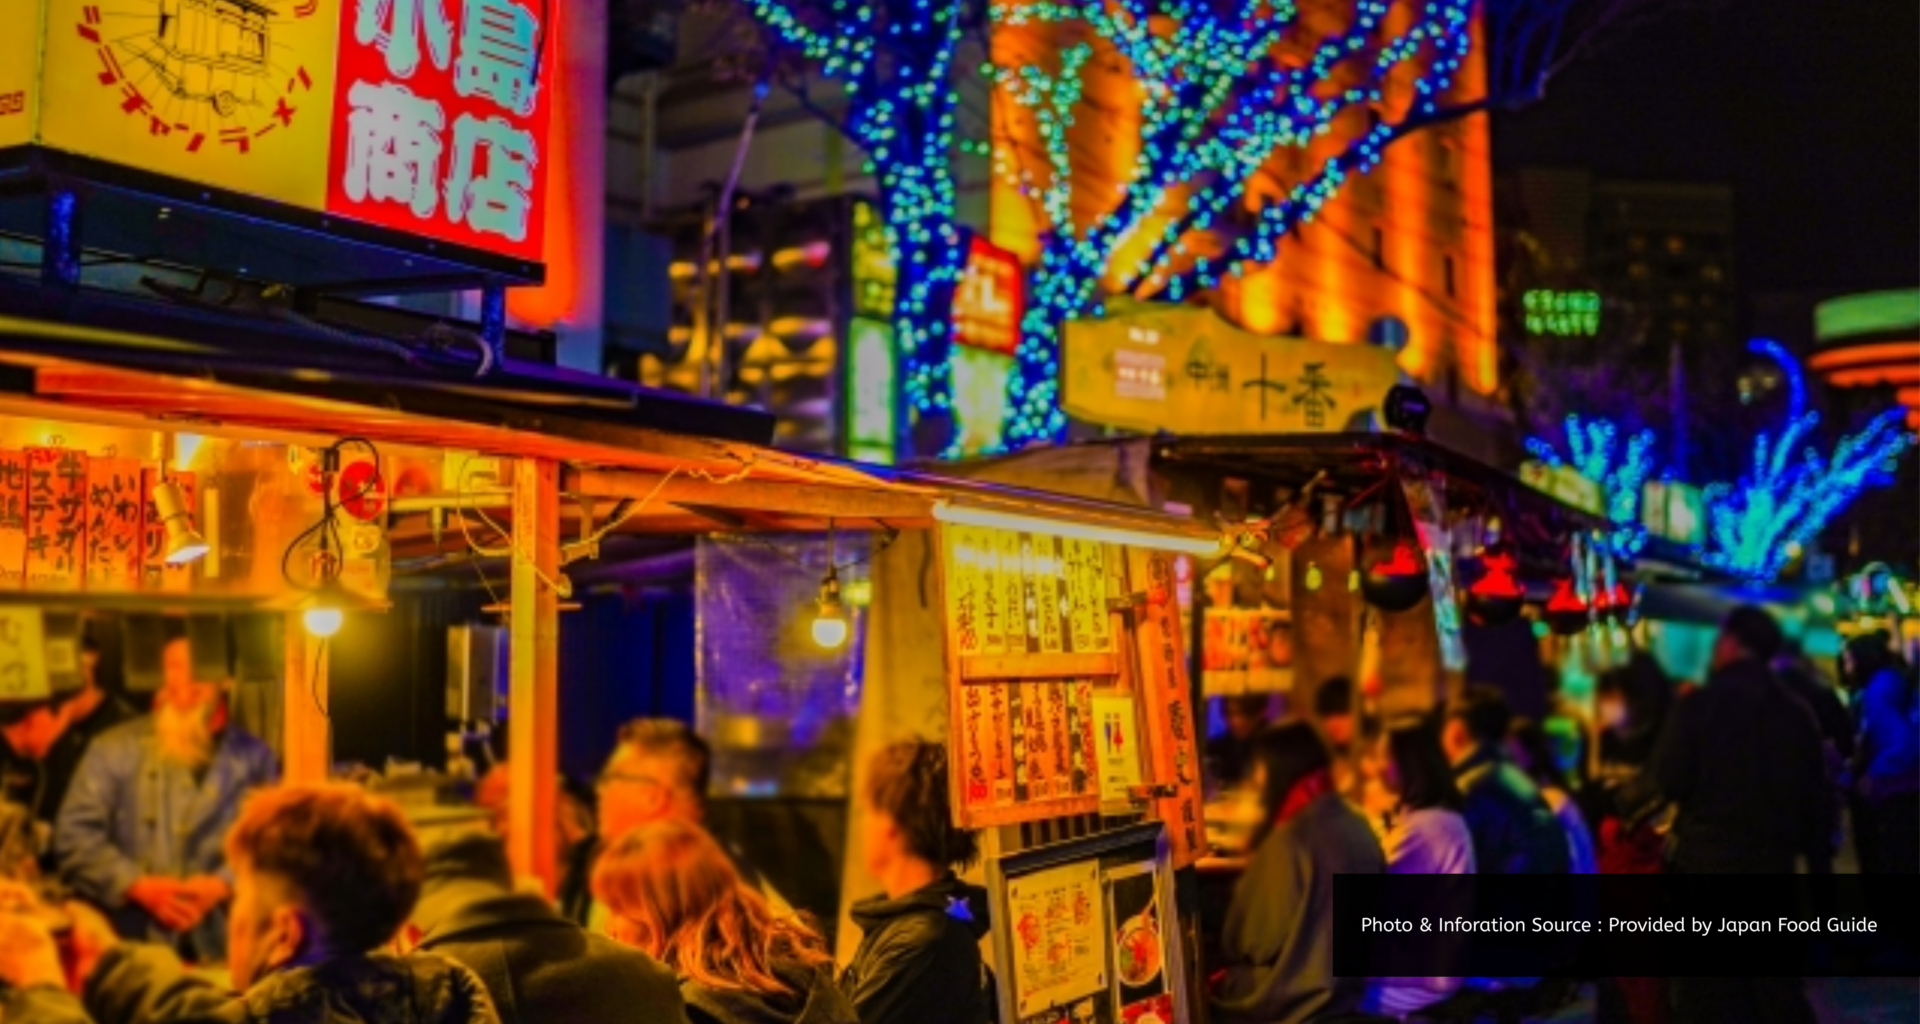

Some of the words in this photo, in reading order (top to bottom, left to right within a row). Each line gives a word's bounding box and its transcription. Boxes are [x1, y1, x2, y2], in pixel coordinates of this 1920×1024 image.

[343, 78, 538, 243] 商店
[1241, 351, 1337, 428] 十番
[112, 472, 138, 551] いわし
